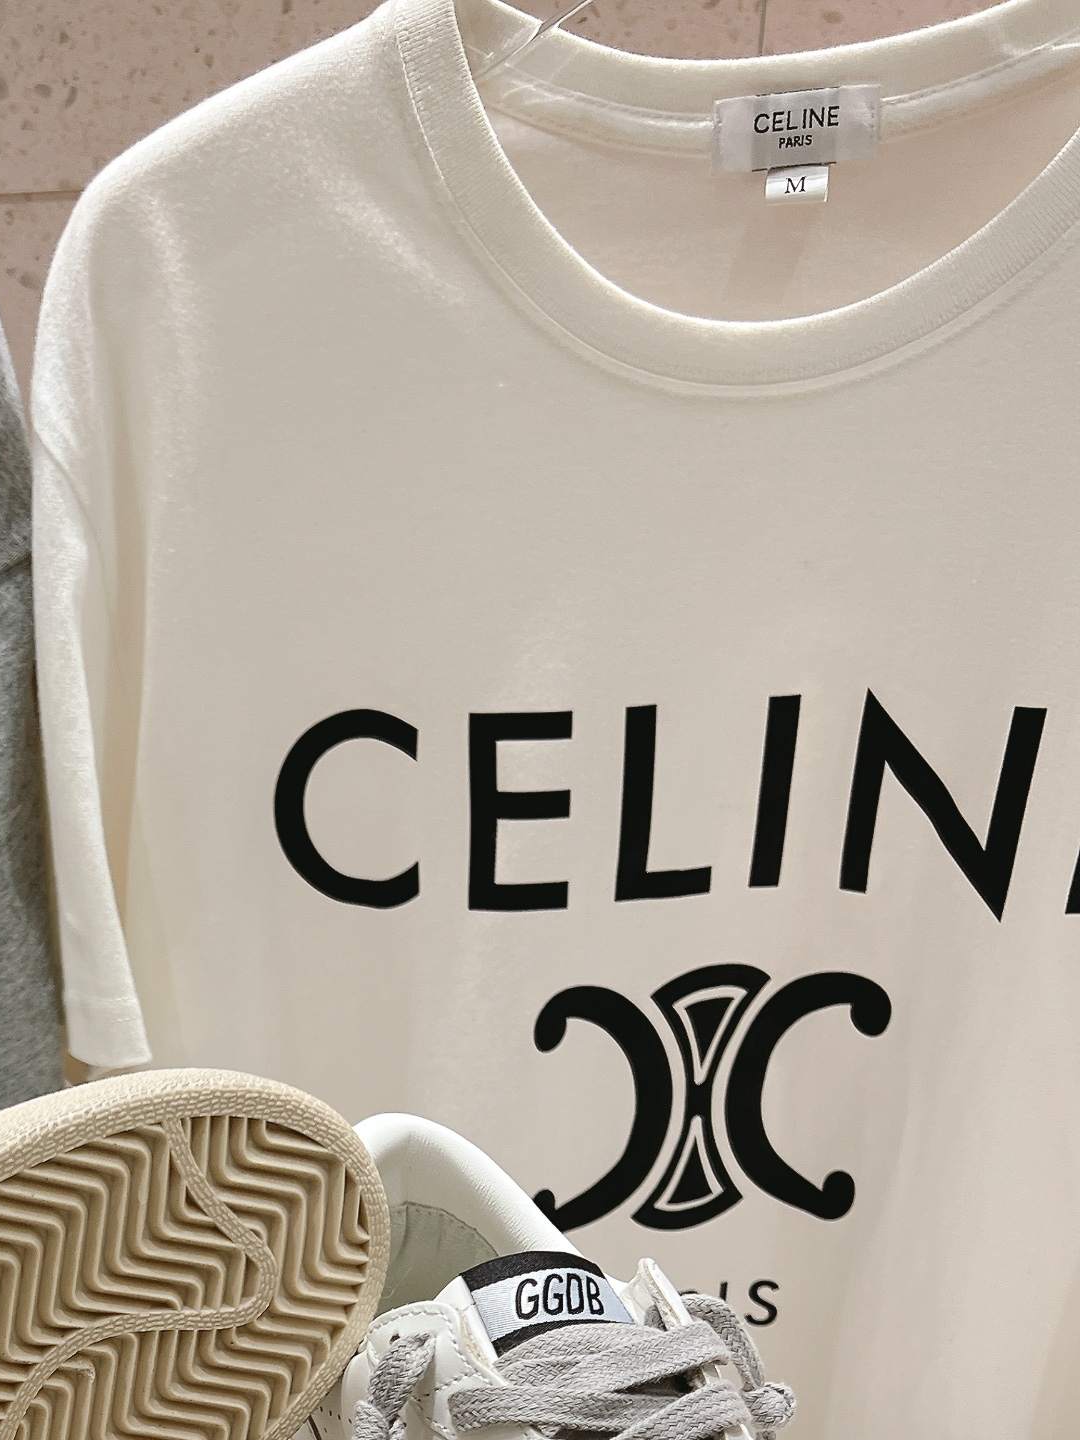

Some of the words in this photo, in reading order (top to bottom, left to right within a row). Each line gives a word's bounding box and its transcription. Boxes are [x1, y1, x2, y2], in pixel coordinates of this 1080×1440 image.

[754, 106, 840, 134] CELINE
[778, 135, 813, 149] PARIS
[785, 176, 807, 194] M
[274, 688, 1080, 922] CELIN
[515, 1273, 605, 1320] GGDB
